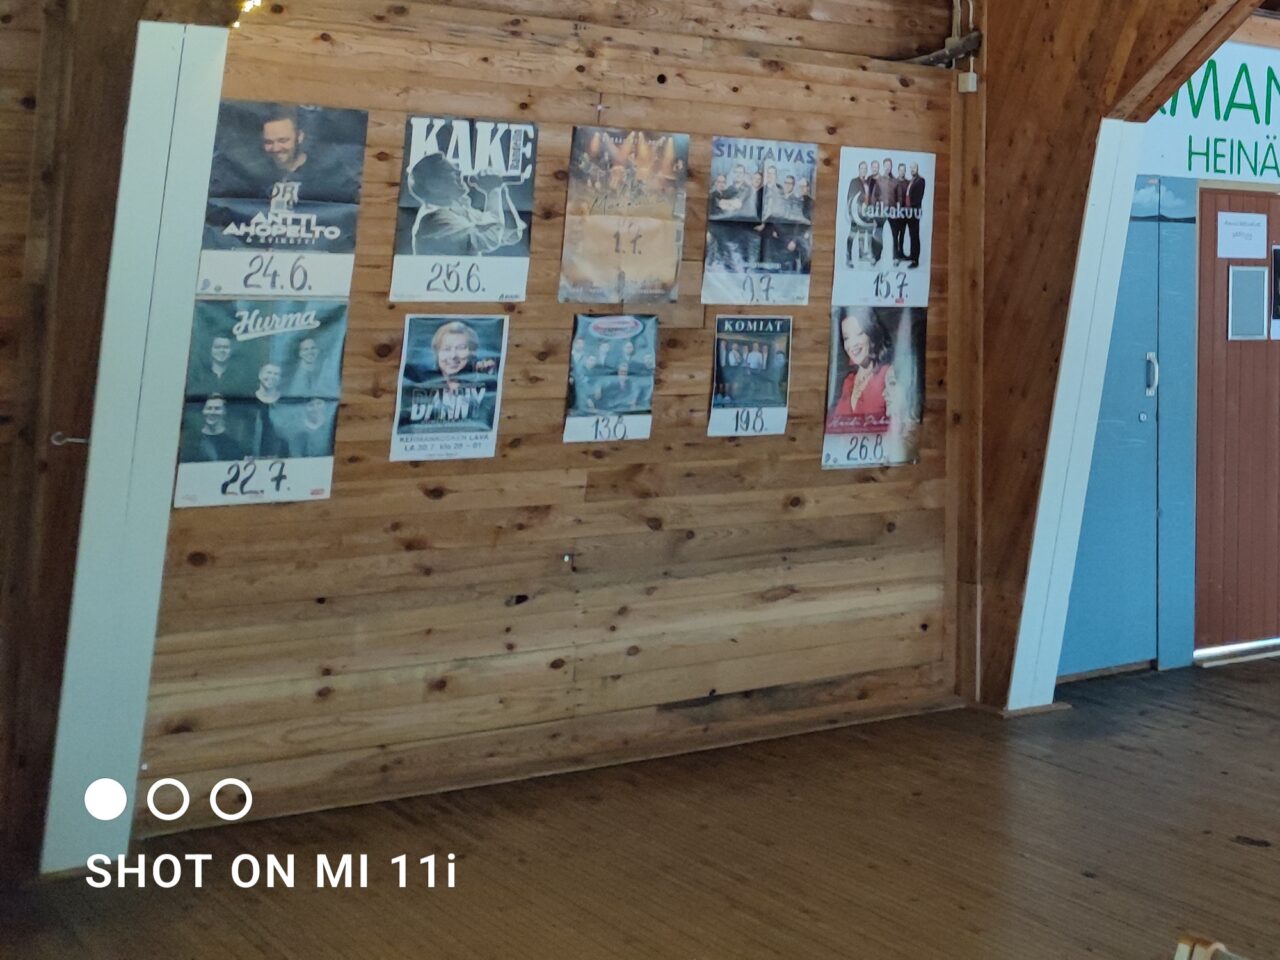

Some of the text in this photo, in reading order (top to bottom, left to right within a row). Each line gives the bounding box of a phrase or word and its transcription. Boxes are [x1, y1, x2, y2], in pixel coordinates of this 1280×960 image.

[408, 117, 535, 179] KAKE
[715, 141, 816, 164] SINITAIVAS
[222, 221, 341, 240] AHOPELTO
[250, 210, 317, 227] ANTTI
[243, 254, 312, 291] 24.6.
[426, 261, 486, 293] 25.6.
[873, 271, 908, 298] 15.7.
[232, 309, 321, 341] Hurma
[724, 319, 785, 332] KOMIAT
[221, 460, 290, 495] 22.7.
